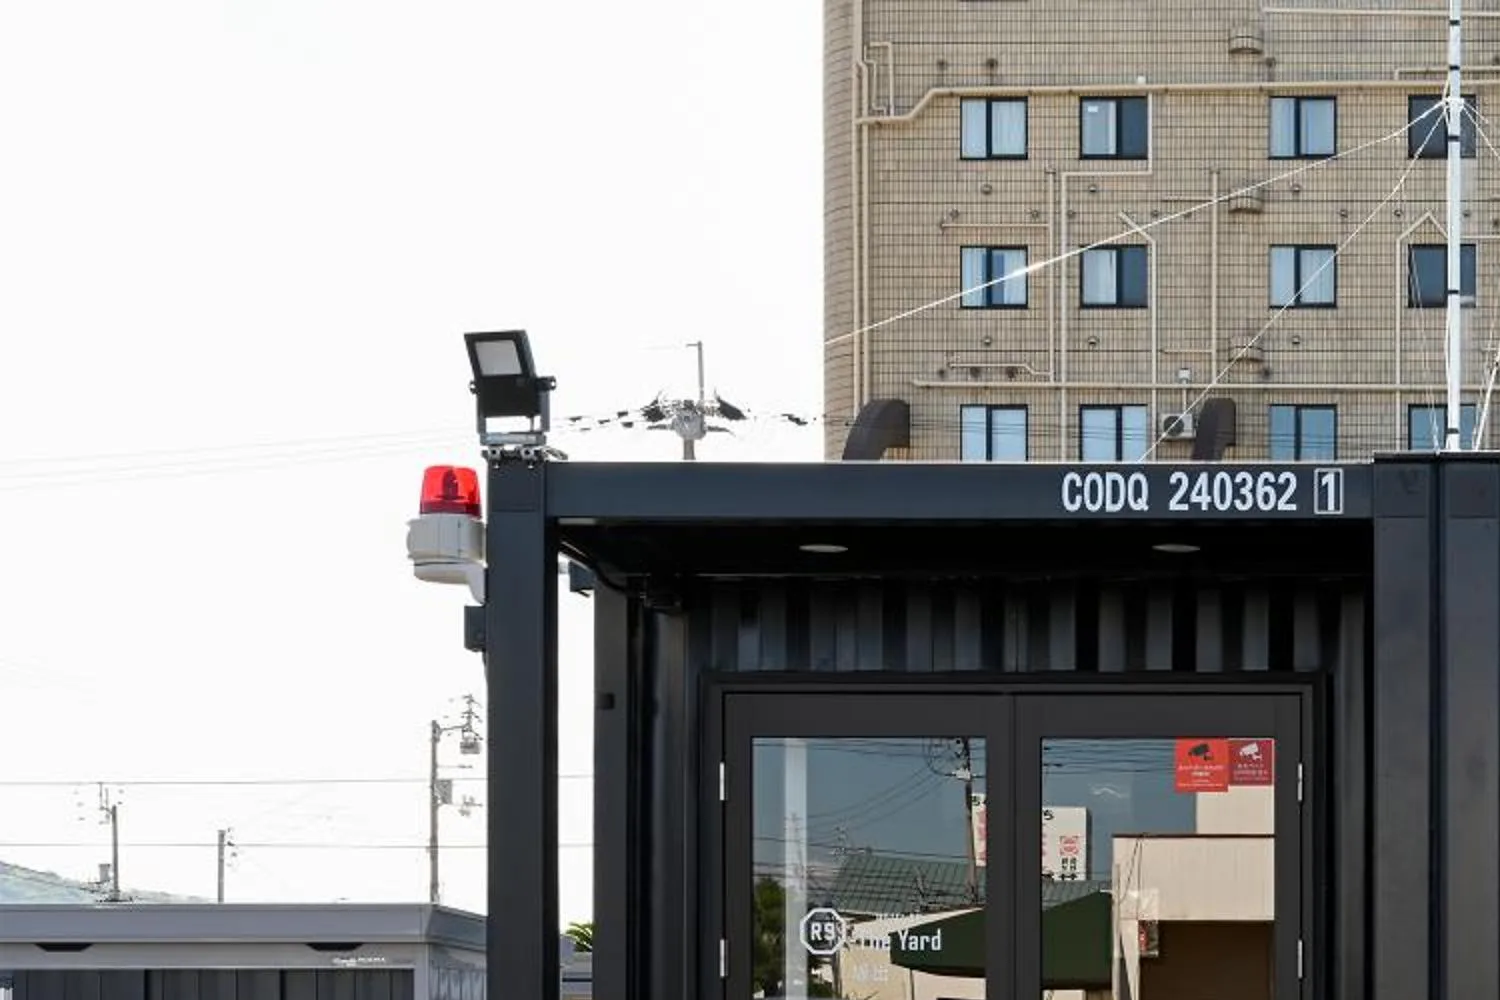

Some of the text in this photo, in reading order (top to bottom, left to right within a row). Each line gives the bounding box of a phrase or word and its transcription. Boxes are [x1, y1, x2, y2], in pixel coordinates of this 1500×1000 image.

[1062, 471, 1339, 513] CODQ 240362 1
[811, 921, 836, 941] R9
[898, 928, 941, 951] Yard
